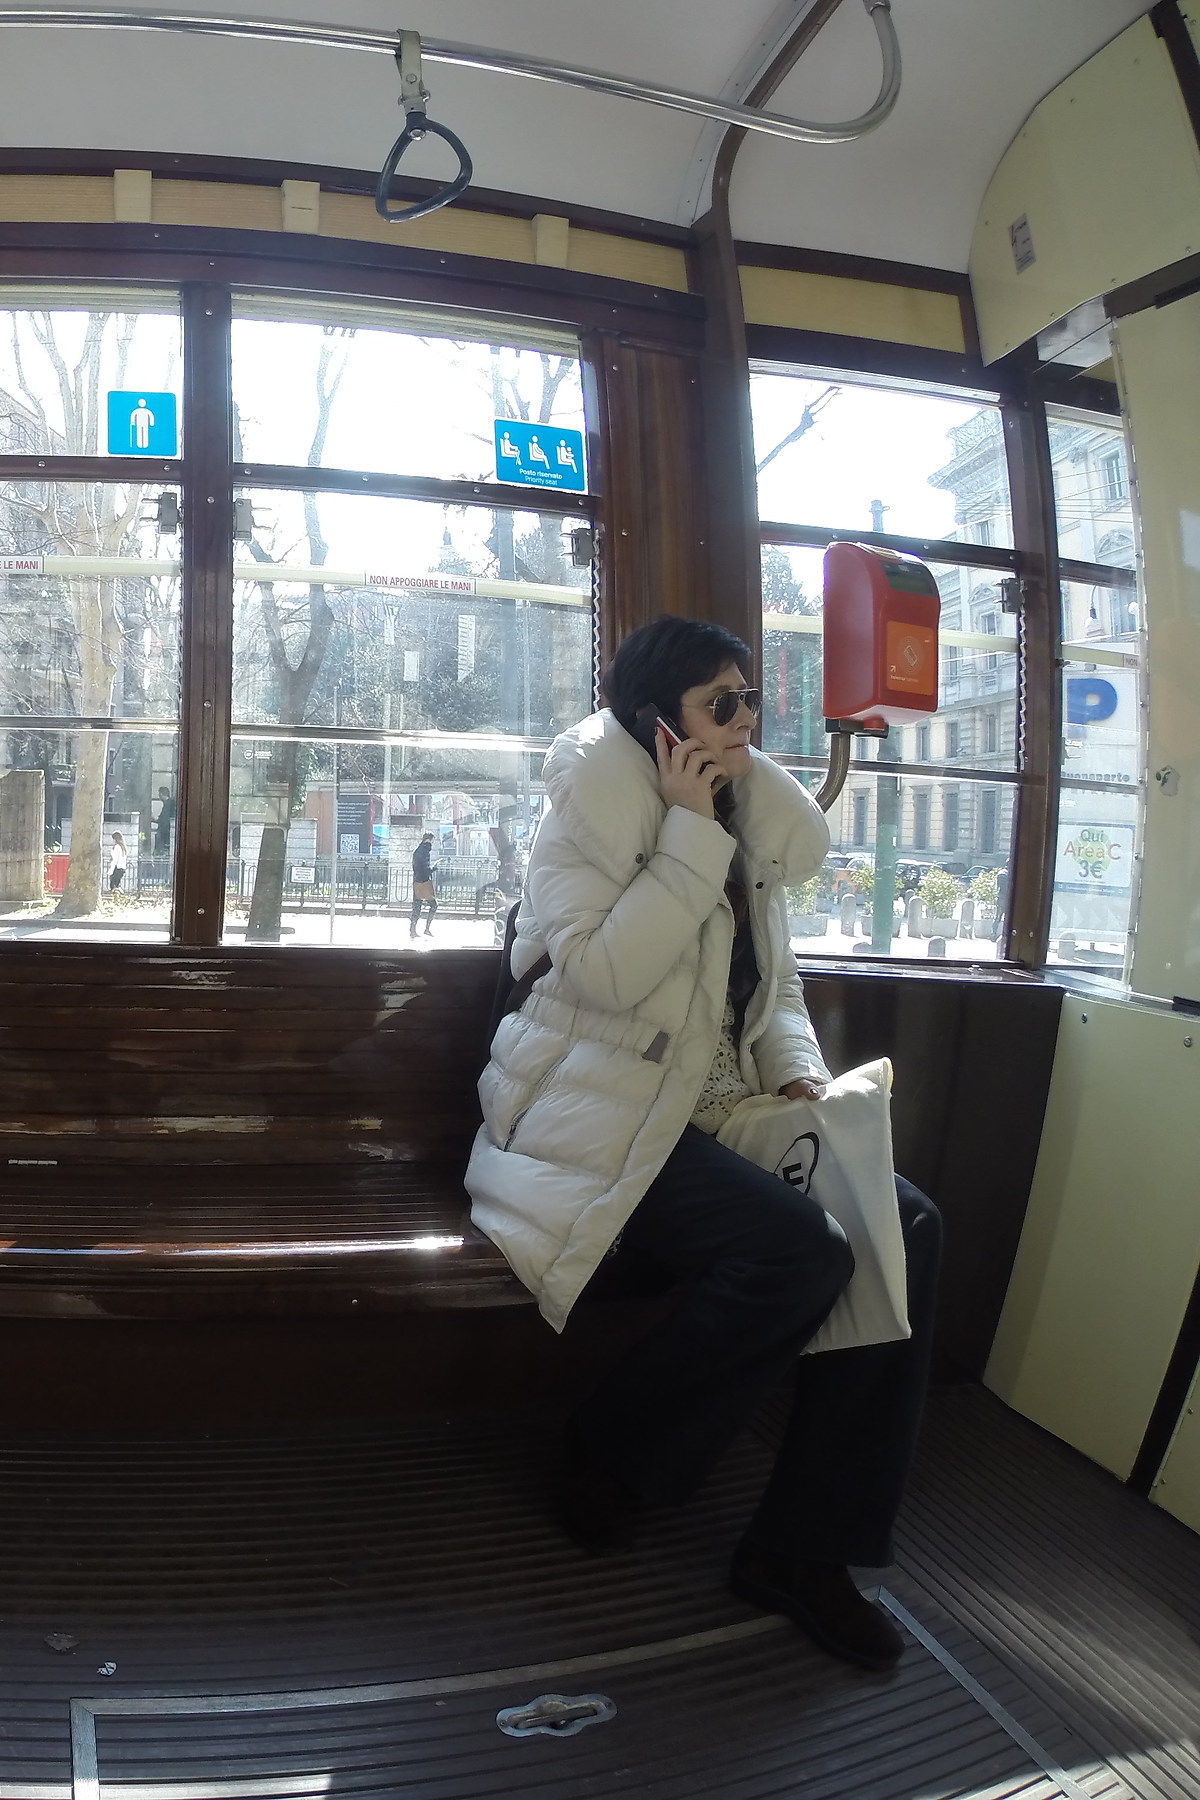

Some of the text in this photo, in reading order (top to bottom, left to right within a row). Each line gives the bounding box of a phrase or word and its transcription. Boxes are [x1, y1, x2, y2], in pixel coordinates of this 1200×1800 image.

[519, 468, 563, 480] Posto riservato
[525, 475, 545, 485] Priority
[3, 561, 13, 570] LE
[15, 561, 39, 570] MANI
[369, 575, 471, 591] NON APPOGGIARE LE MANI
[1125, 657, 1138, 667] NON
[1067, 678, 1118, 739] P
[1080, 829, 1104, 843] Qui
[1063, 841, 1122, 860] Area C
[1078, 860, 1103, 879] 3€
